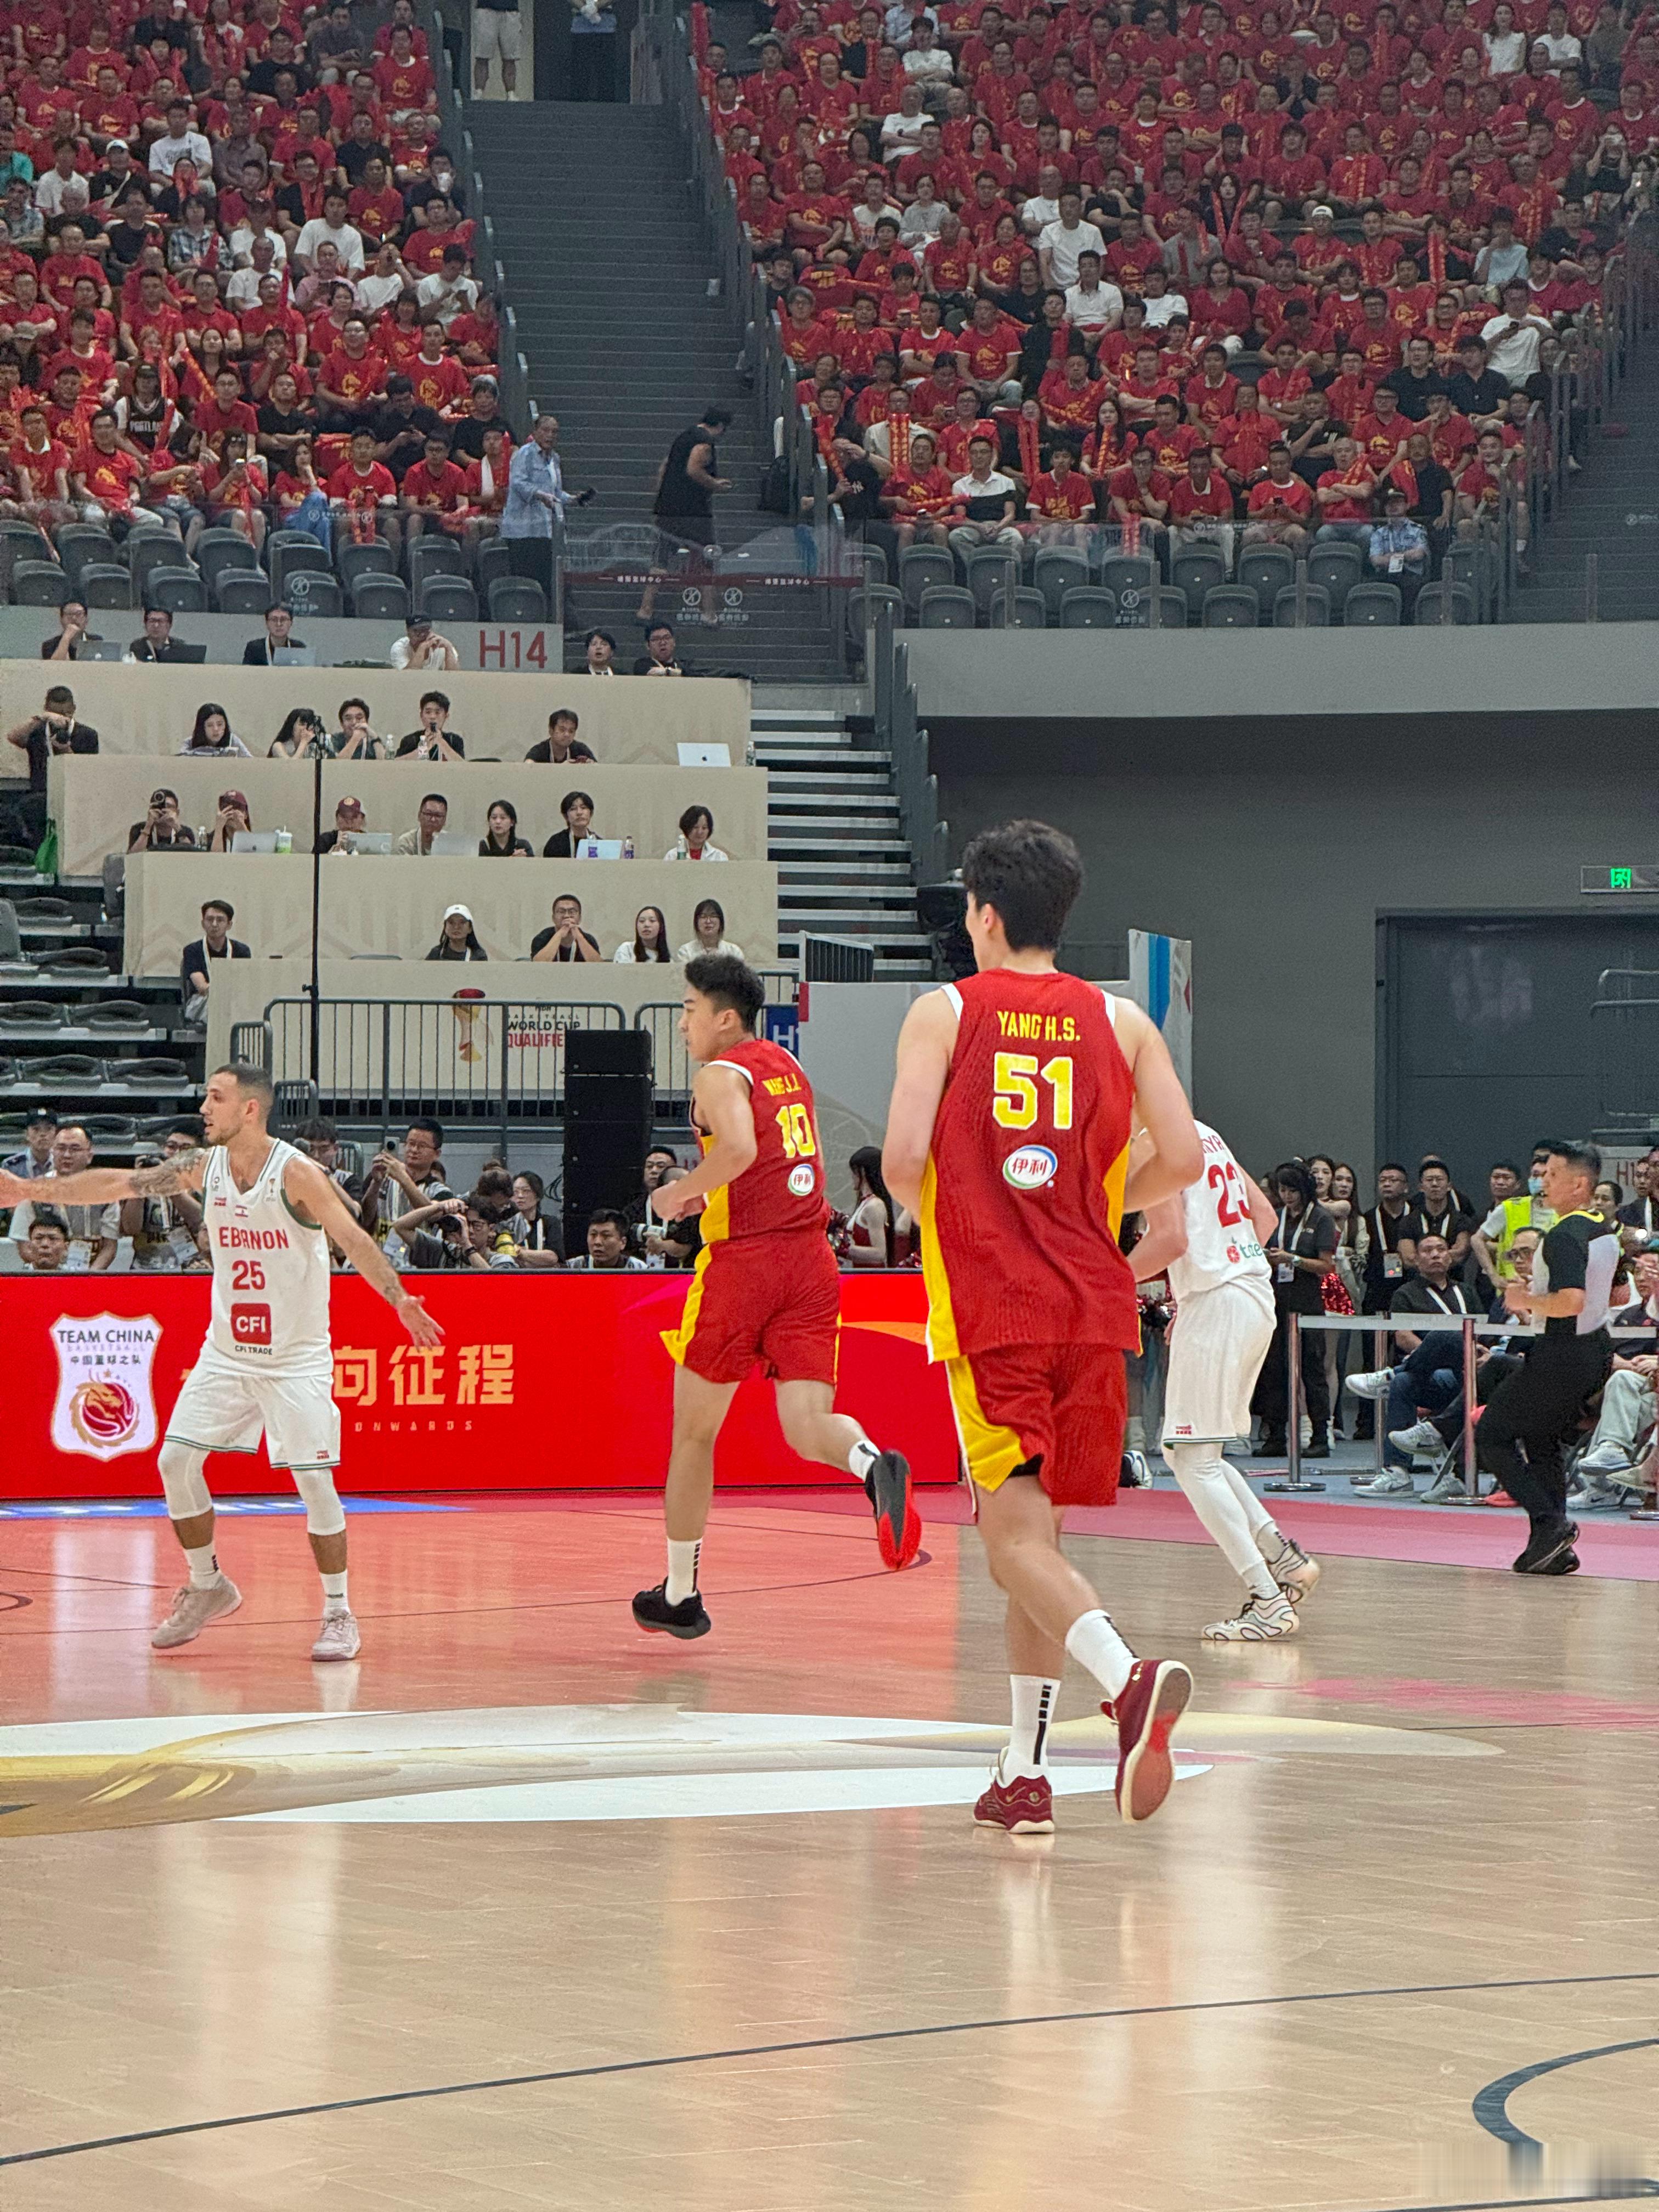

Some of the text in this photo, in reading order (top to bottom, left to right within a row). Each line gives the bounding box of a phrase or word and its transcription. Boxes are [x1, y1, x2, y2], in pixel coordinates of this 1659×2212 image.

[479, 629, 548, 669] H14
[996, 1011, 1081, 1042] YANG H.S.
[992, 1051, 1073, 1131] 51
[775, 1103, 816, 1159] 10
[1012, 1156, 1048, 1176] 伊利
[232, 1260, 266, 1290] 25
[57, 1329, 155, 1344] TEAM CHINA
[236, 1316, 267, 1333] CFI
[247, 1346, 273, 1356] TRADE
